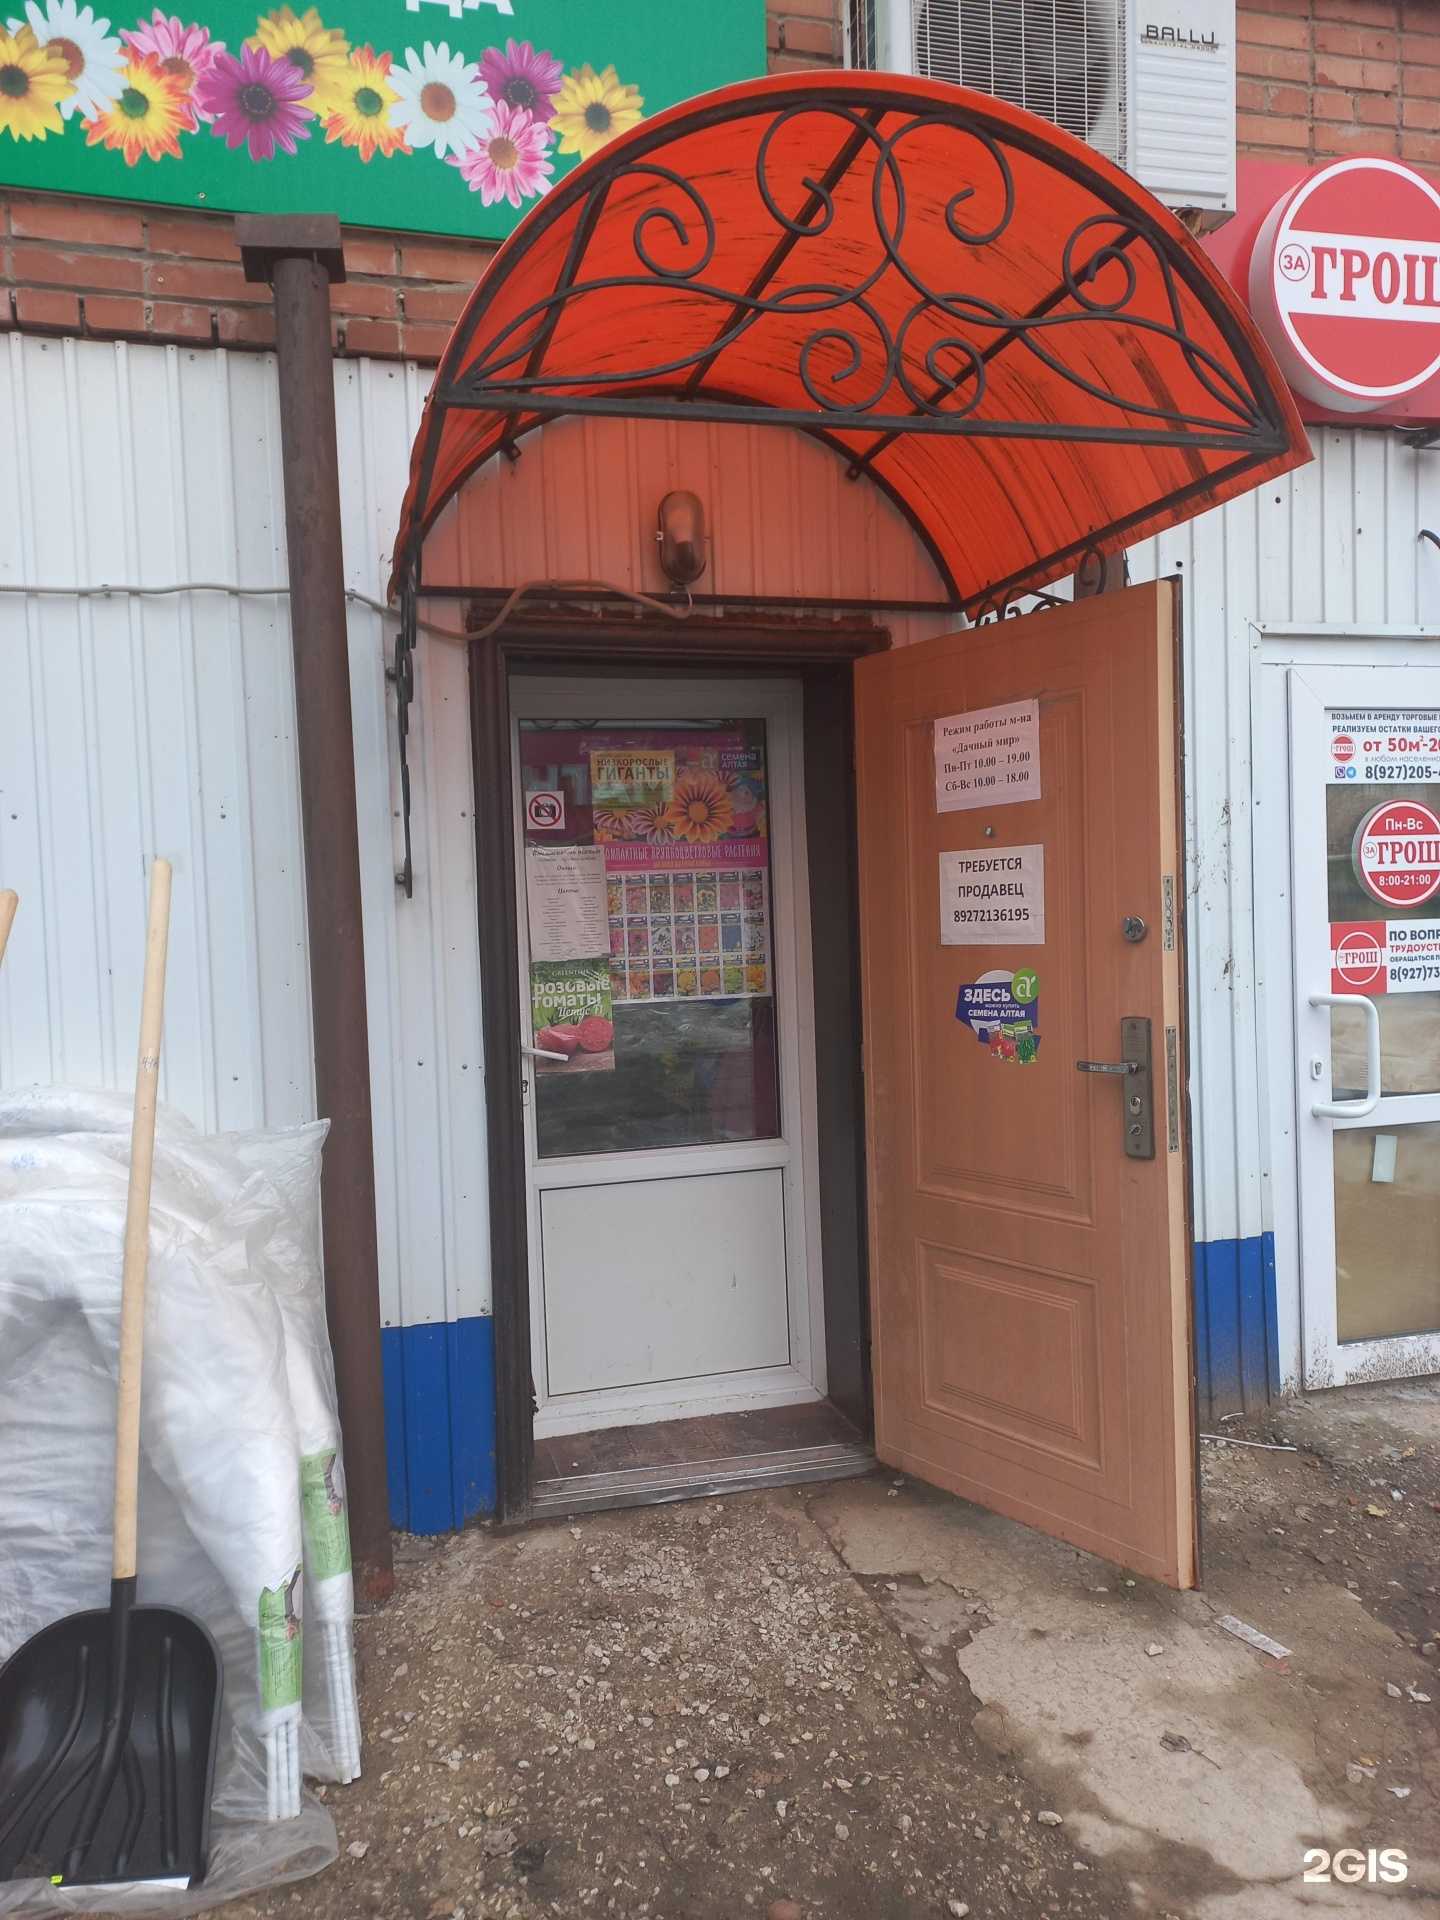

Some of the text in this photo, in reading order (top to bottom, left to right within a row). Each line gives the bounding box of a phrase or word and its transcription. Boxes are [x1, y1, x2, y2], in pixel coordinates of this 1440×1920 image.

[1146, 24, 1214, 44] BALLU
[1284, 254, 1305, 271] ЗА
[1331, 713, 1366, 721] ВОЗЬМЕМ
[1374, 713, 1400, 722] АРЕНДУ
[1402, 713, 1438, 721] ТОРГОВЫЕ
[943, 714, 1032, 737] Режим работы м-на
[1332, 725, 1377, 733] РЕАЛИЗУЕМ
[1379, 725, 1412, 733] ОСТАТКИ
[952, 736, 1020, 754] «Дачный мир»
[1363, 741, 1382, 752] от
[944, 761, 971, 773] Пн-Пт
[974, 757, 996, 769] 10.00
[1007, 751, 1030, 764] 19.00
[597, 767, 670, 780] ГИГАНТЫ
[1365, 764, 1440, 780] 8(927)205-
[945, 780, 971, 791] Сб-Вс
[973, 776, 996, 788] 10.00
[1006, 771, 1029, 784] 18.00
[1385, 818, 1424, 830] Пн-Вс
[1377, 841, 1440, 864] ГРОШ
[958, 857, 1022, 873] ТРЕБУЕТСЯ
[1379, 874, 1431, 886] 8:00-21:00
[958, 883, 1024, 899] ПРОДАВЕЦ
[953, 908, 1030, 922] 89272136195
[1389, 930, 1407, 941] ПО
[1389, 943, 1440, 953] ТРУДОУСТ
[1344, 951, 1378, 964] ГРОШ
[1390, 954, 1434, 962] ОБРАЩАТЬСЯ
[964, 988, 1010, 1003] ЗДЕСЬ
[968, 1009, 1026, 1017] СЕМЕНА АЛТАЯ
